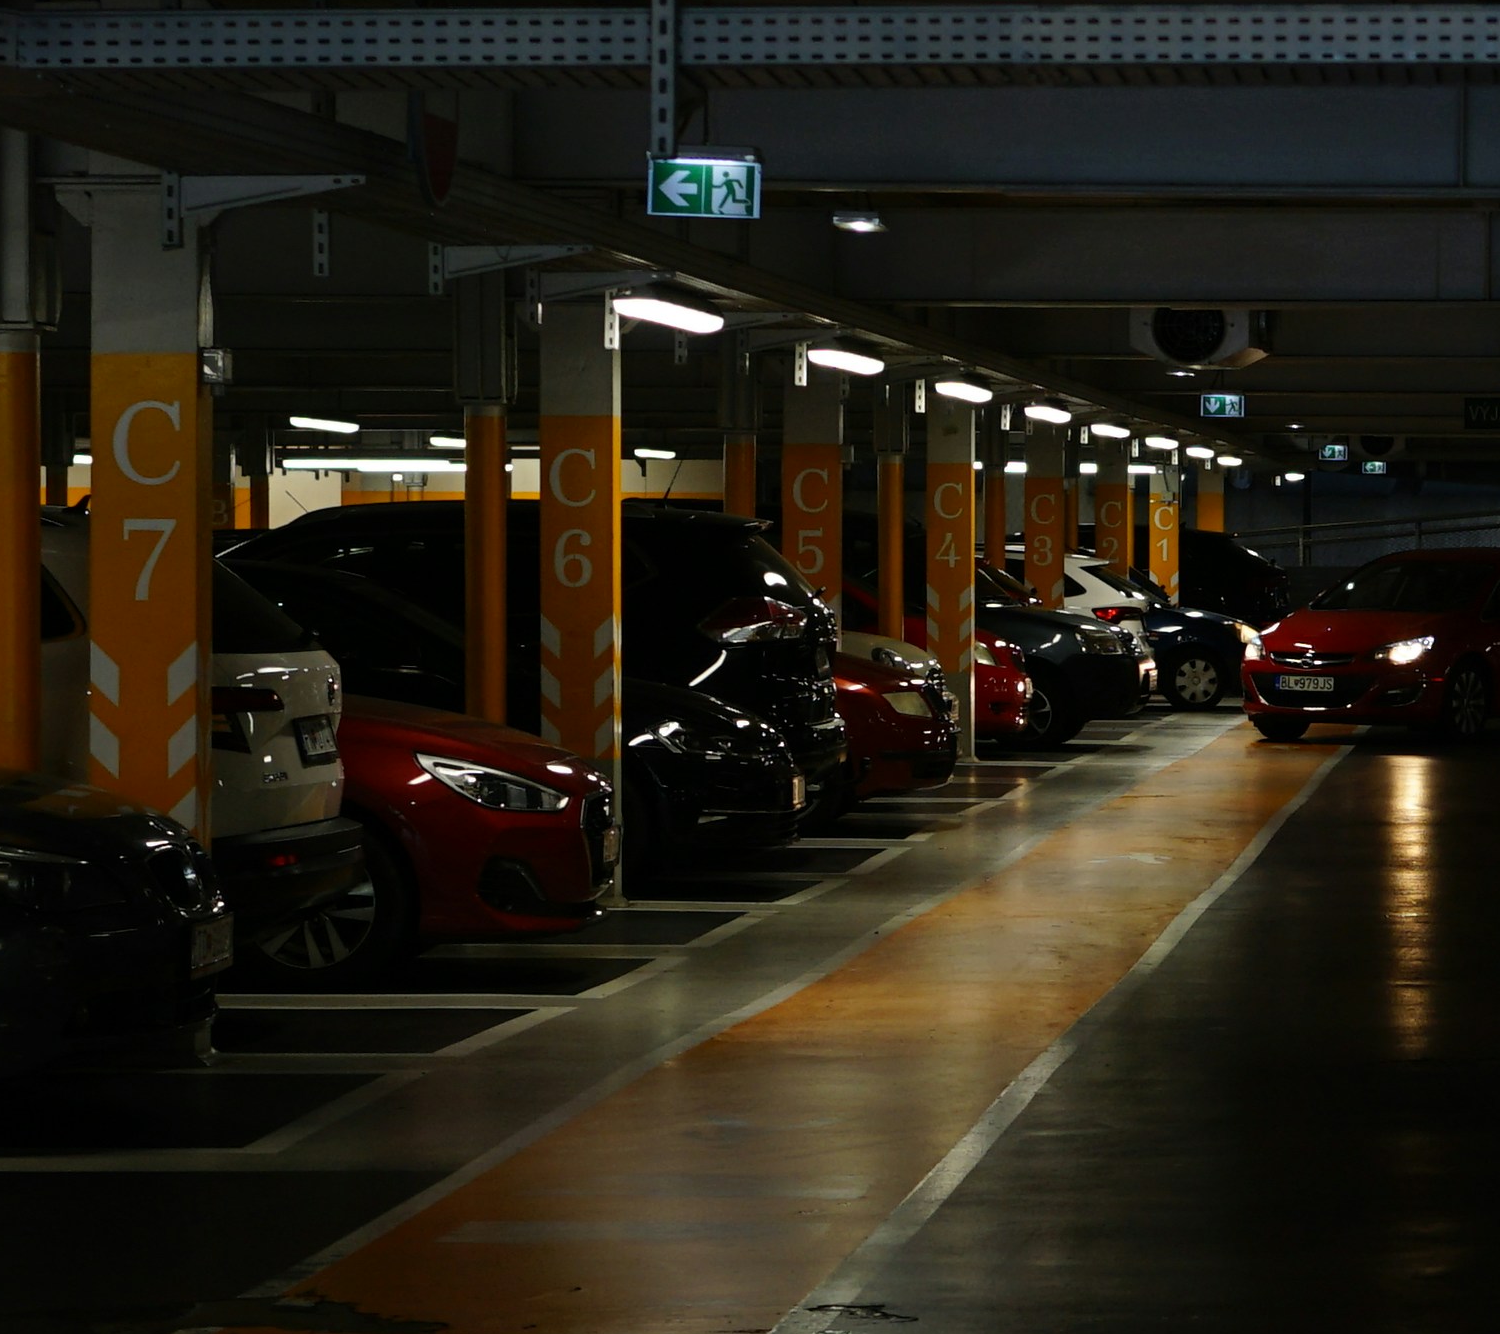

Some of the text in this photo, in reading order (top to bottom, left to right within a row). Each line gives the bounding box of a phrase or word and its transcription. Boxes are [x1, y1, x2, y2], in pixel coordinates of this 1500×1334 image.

[112, 399, 181, 486] C
[549, 447, 596, 508] C
[792, 467, 829, 514] C
[933, 482, 963, 519] C
[1030, 494, 1056, 525] C
[1100, 501, 1123, 528] C
[1153, 506, 1175, 531] C
[123, 518, 178, 602] 7
[553, 528, 593, 588] 6
[796, 527, 825, 575] 5
[933, 532, 962, 568] 4
[1032, 536, 1053, 567] 3
[1101, 537, 1120, 564] 2
[1156, 538, 1169, 563] 1
